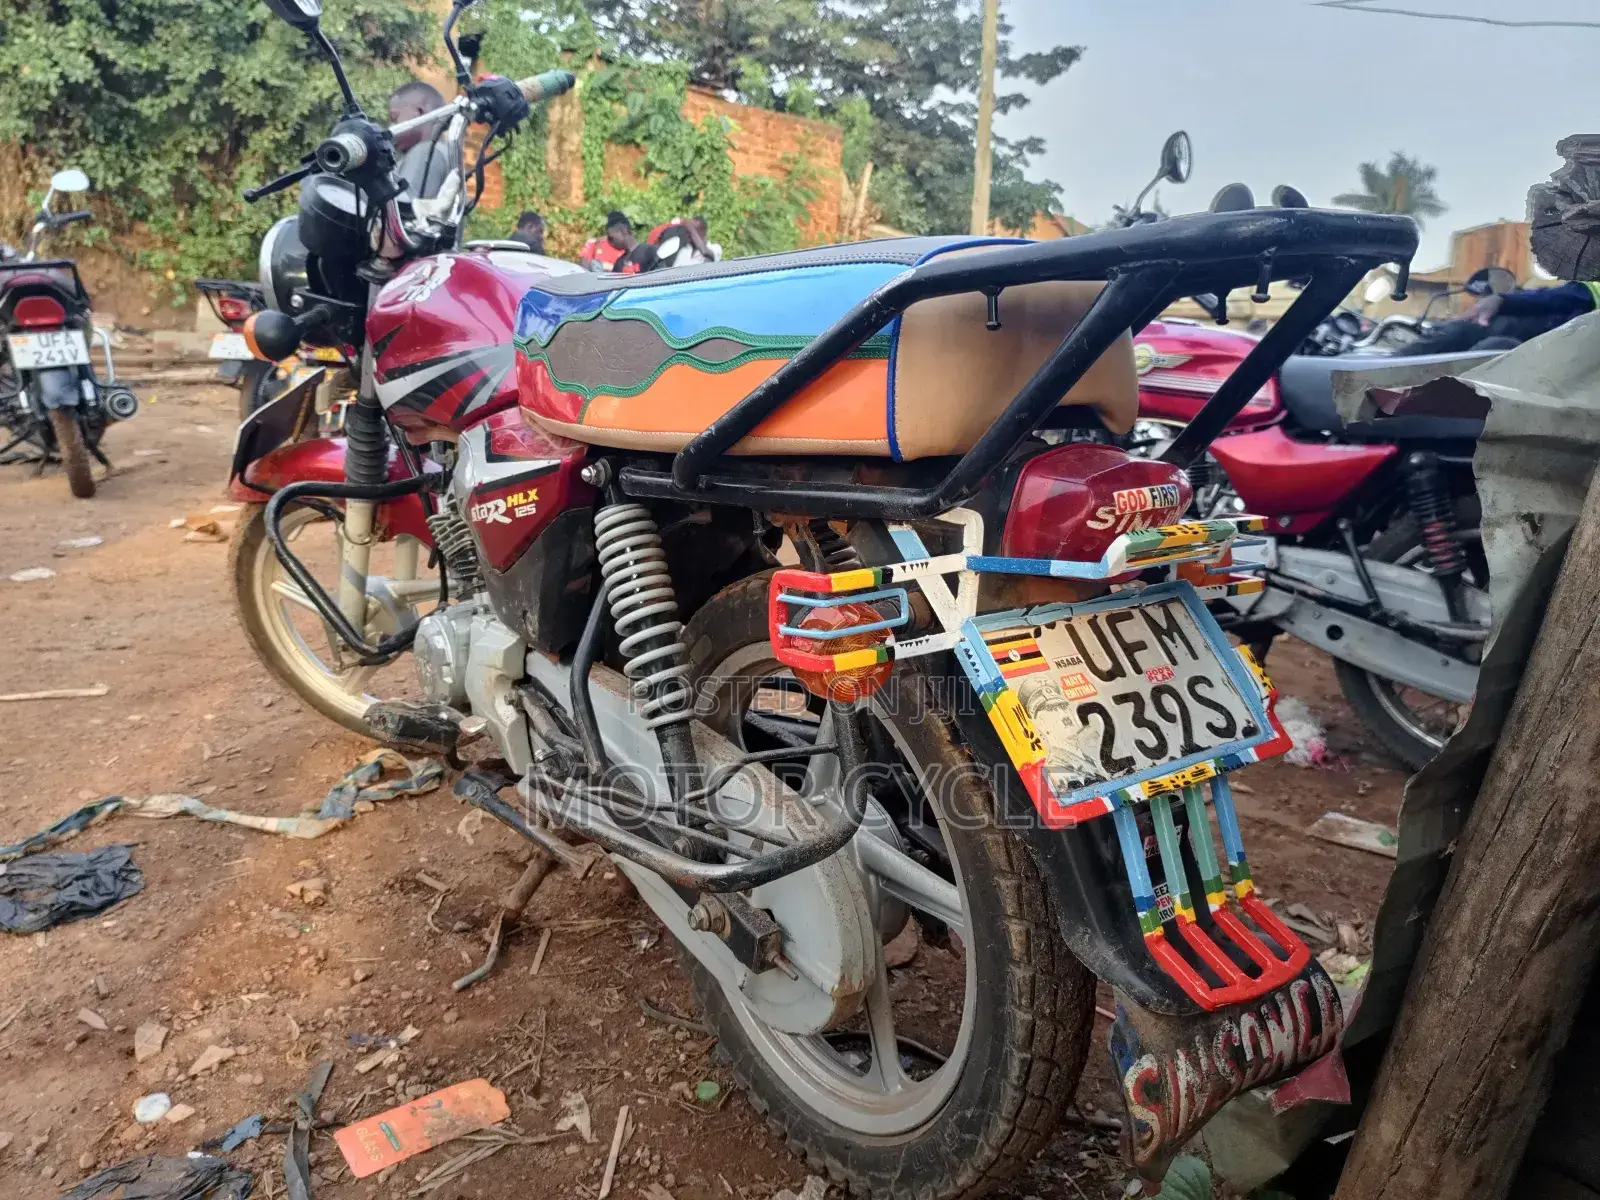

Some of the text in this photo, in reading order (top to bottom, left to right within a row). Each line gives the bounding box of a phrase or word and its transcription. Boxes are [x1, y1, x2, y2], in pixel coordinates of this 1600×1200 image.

[506, 488, 539, 508] HLX
[1116, 485, 1179, 513] GOD FIRST
[514, 503, 537, 518] 125
[1065, 603, 1200, 683] UFM
[1054, 655, 1084, 670] NSABA
[1145, 665, 1171, 677] GOD'S
[1147, 671, 1175, 683] PLAN
[1077, 674, 1237, 773] 239S
